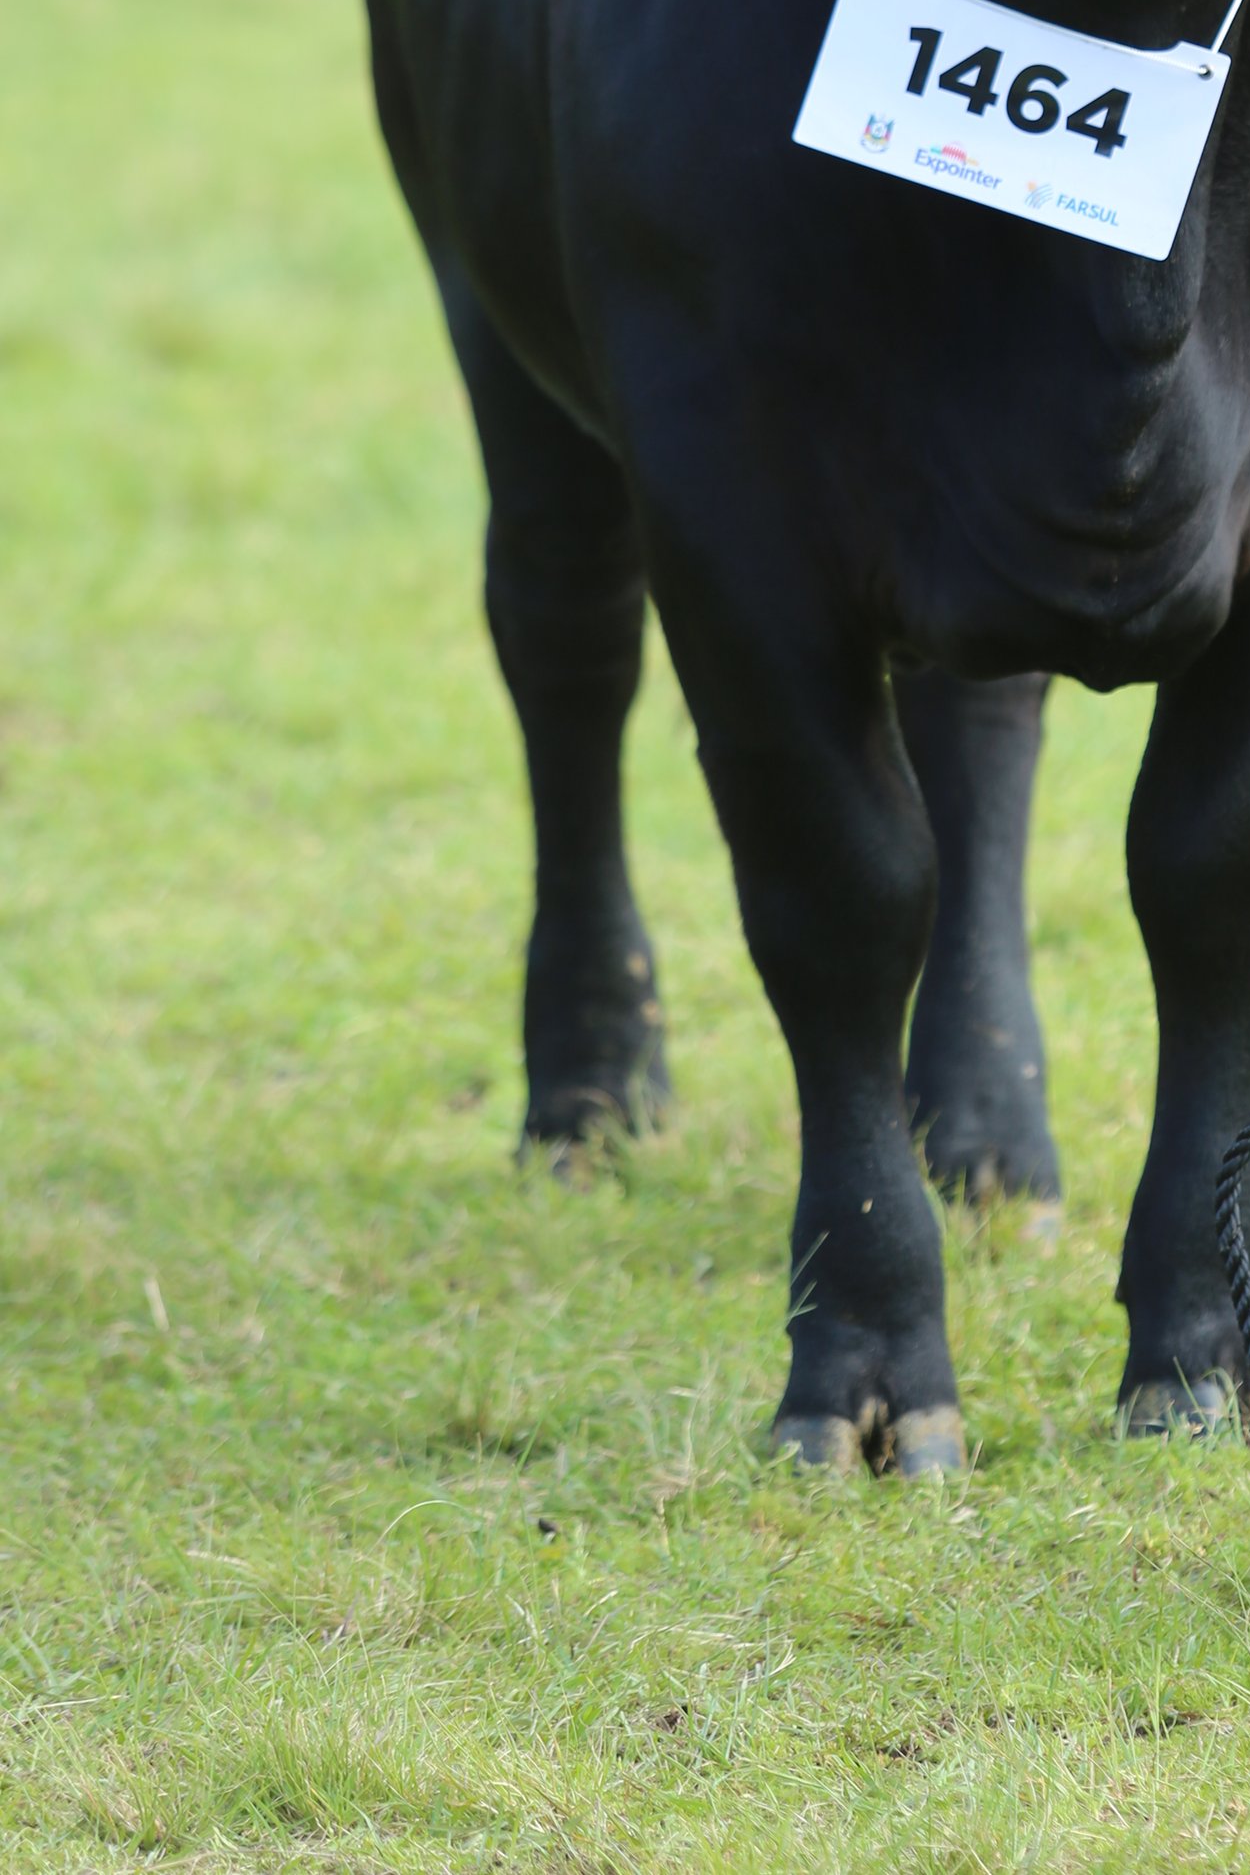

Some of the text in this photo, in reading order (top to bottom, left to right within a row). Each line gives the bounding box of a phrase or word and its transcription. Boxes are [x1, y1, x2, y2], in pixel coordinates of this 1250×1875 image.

[905, 26, 1132, 159] 1464
[914, 147, 1003, 190] Expointer
[1056, 194, 1120, 227] FARSUL
